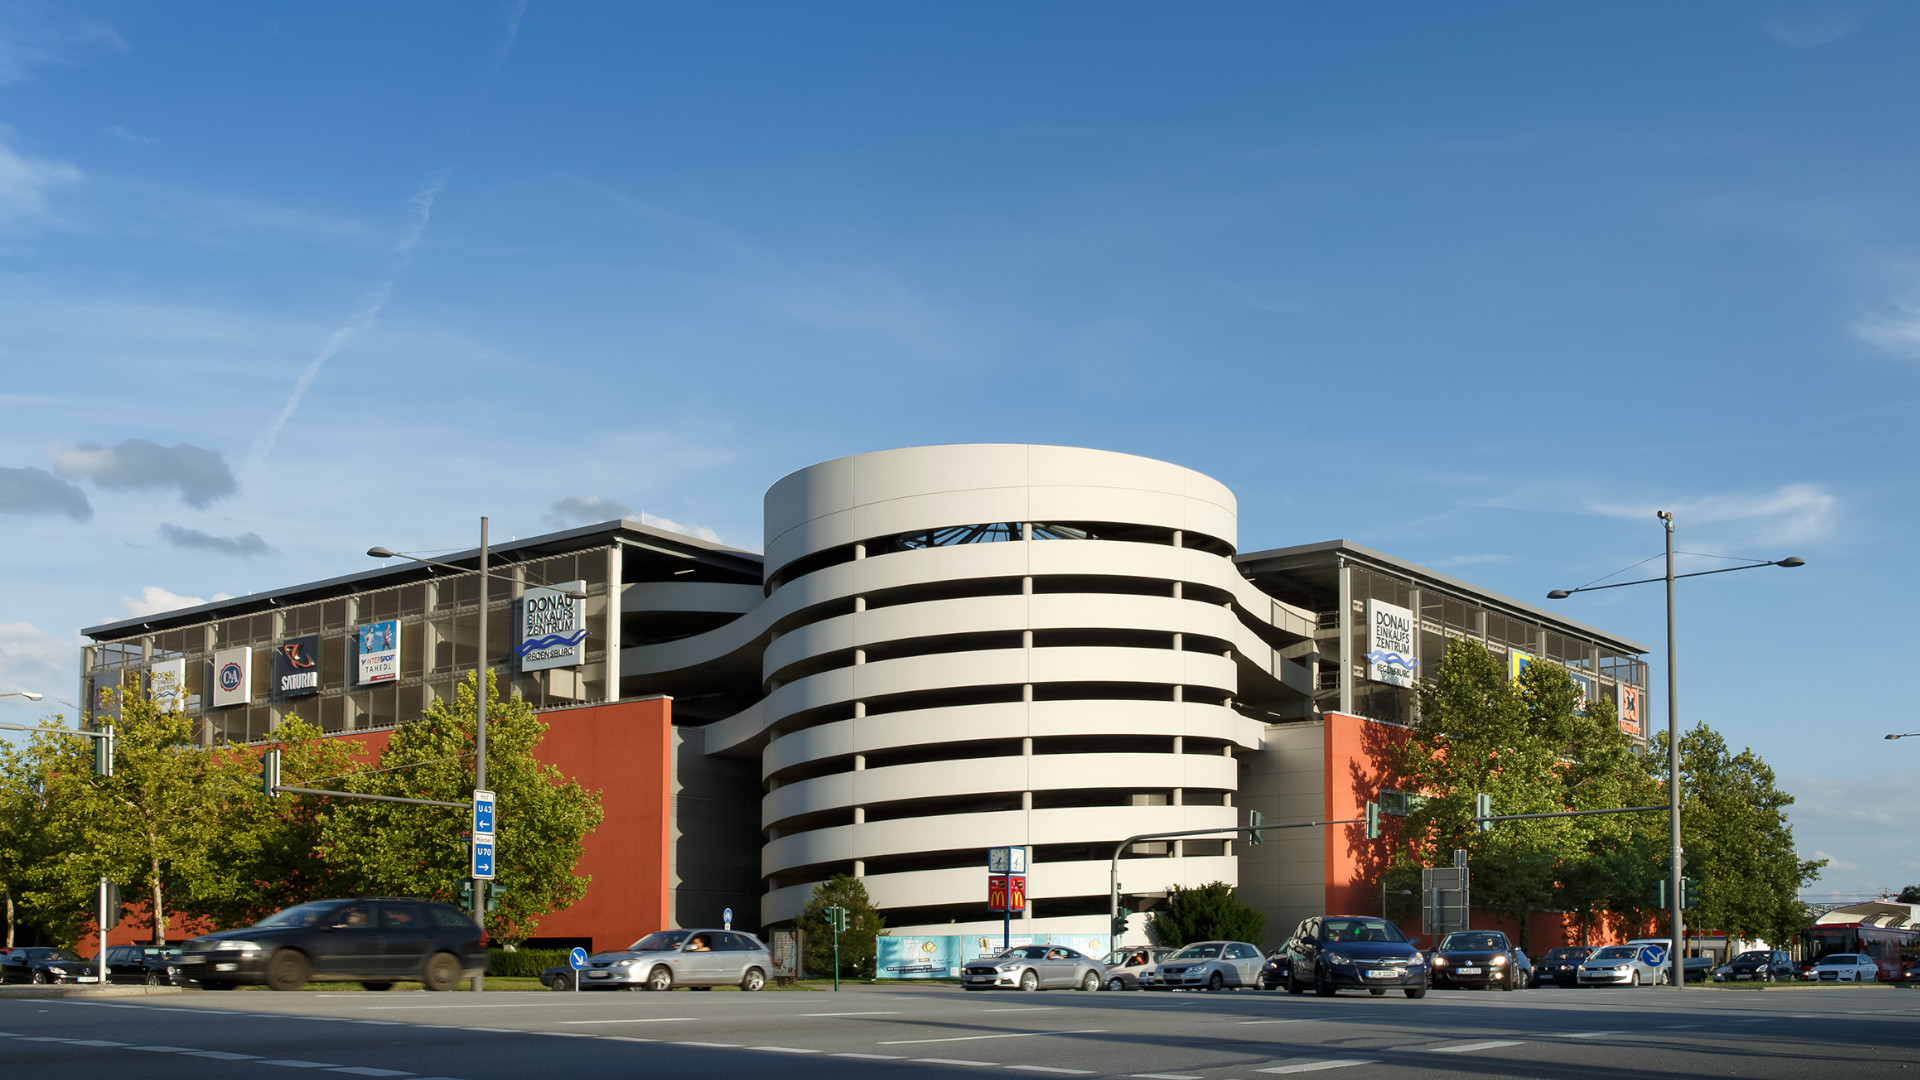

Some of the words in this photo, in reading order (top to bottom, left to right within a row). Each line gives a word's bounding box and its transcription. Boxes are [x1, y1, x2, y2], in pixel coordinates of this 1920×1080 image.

[528, 594, 575, 613] DONAU
[528, 607, 574, 625] EINKAUFS
[1376, 610, 1410, 633] DONAU
[528, 620, 574, 637] ZENTRUM
[1376, 625, 1410, 644] EINKAUFS
[527, 647, 574, 661] REGENSBURG
[1376, 636, 1410, 655] ZENTRUM
[365, 663, 392, 673] TAHEDL
[366, 654, 395, 665] INTERSPORT
[223, 669, 239, 685] C&A
[1376, 663, 1411, 679] REGENSBURG
[281, 671, 318, 691] SATURN
